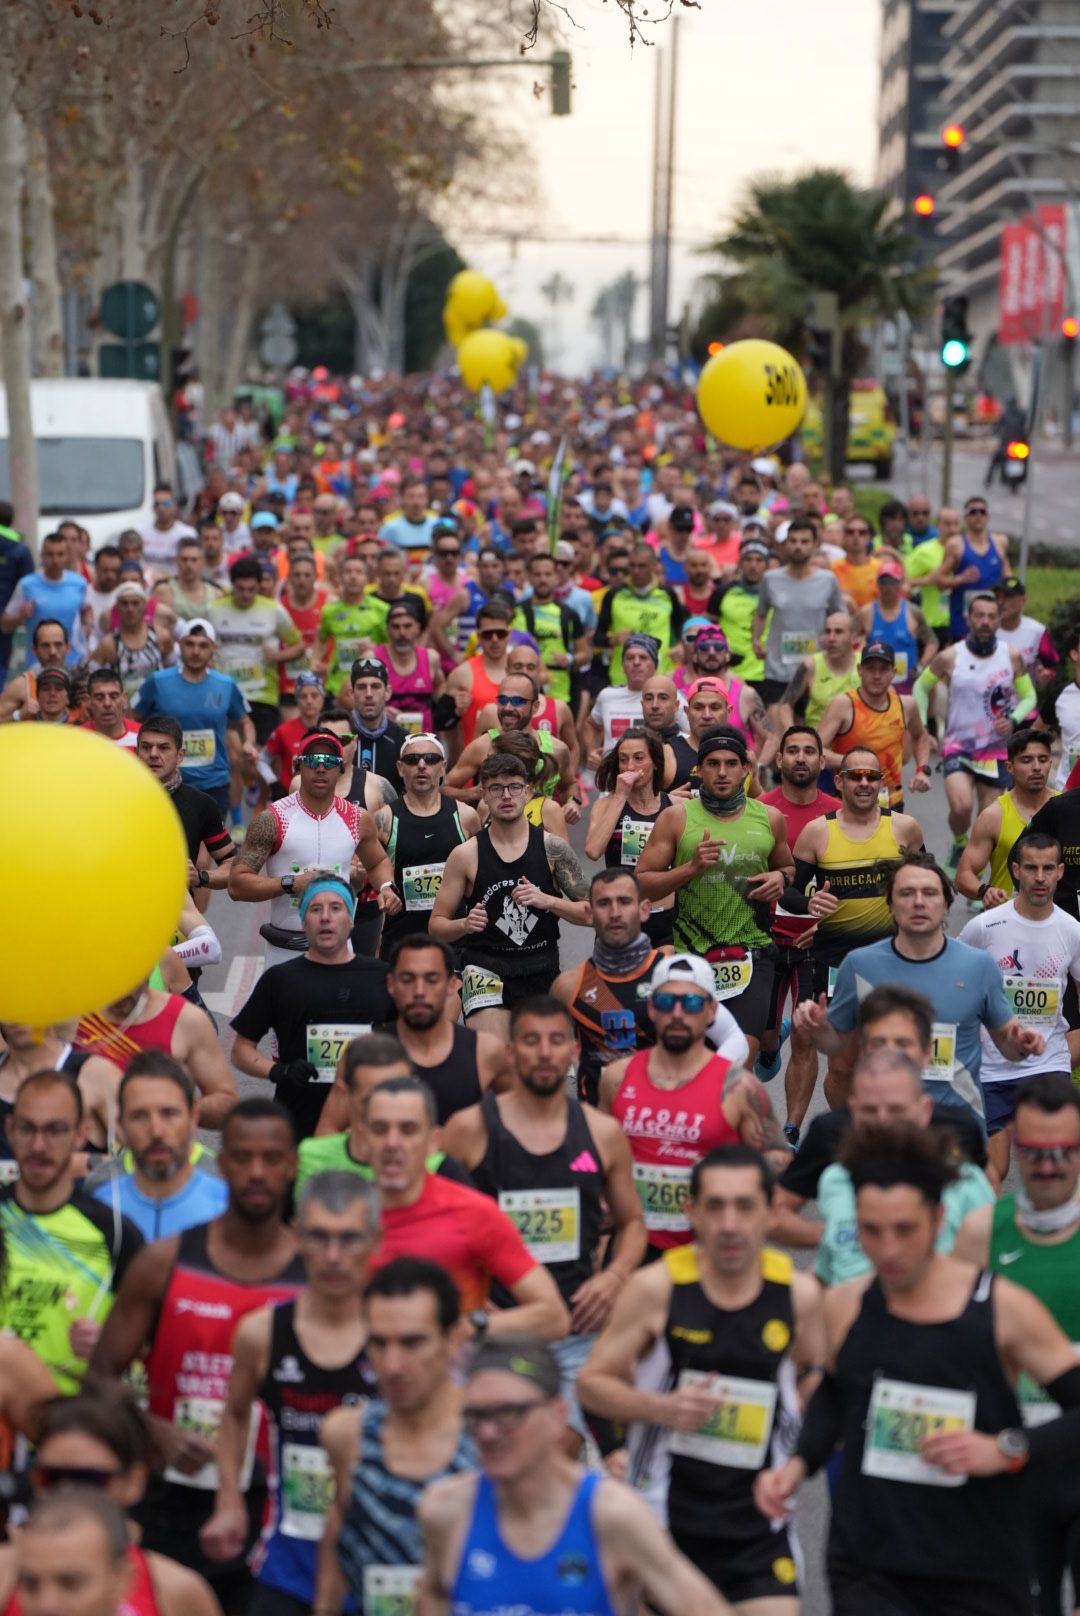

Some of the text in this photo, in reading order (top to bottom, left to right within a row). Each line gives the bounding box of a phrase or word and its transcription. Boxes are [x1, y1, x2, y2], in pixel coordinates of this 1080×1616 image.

[1014, 990, 1047, 1008] 600
[626, 1106, 704, 1127] SPORT
[647, 1182, 689, 1206] 266
[519, 1208, 563, 1235] 225
